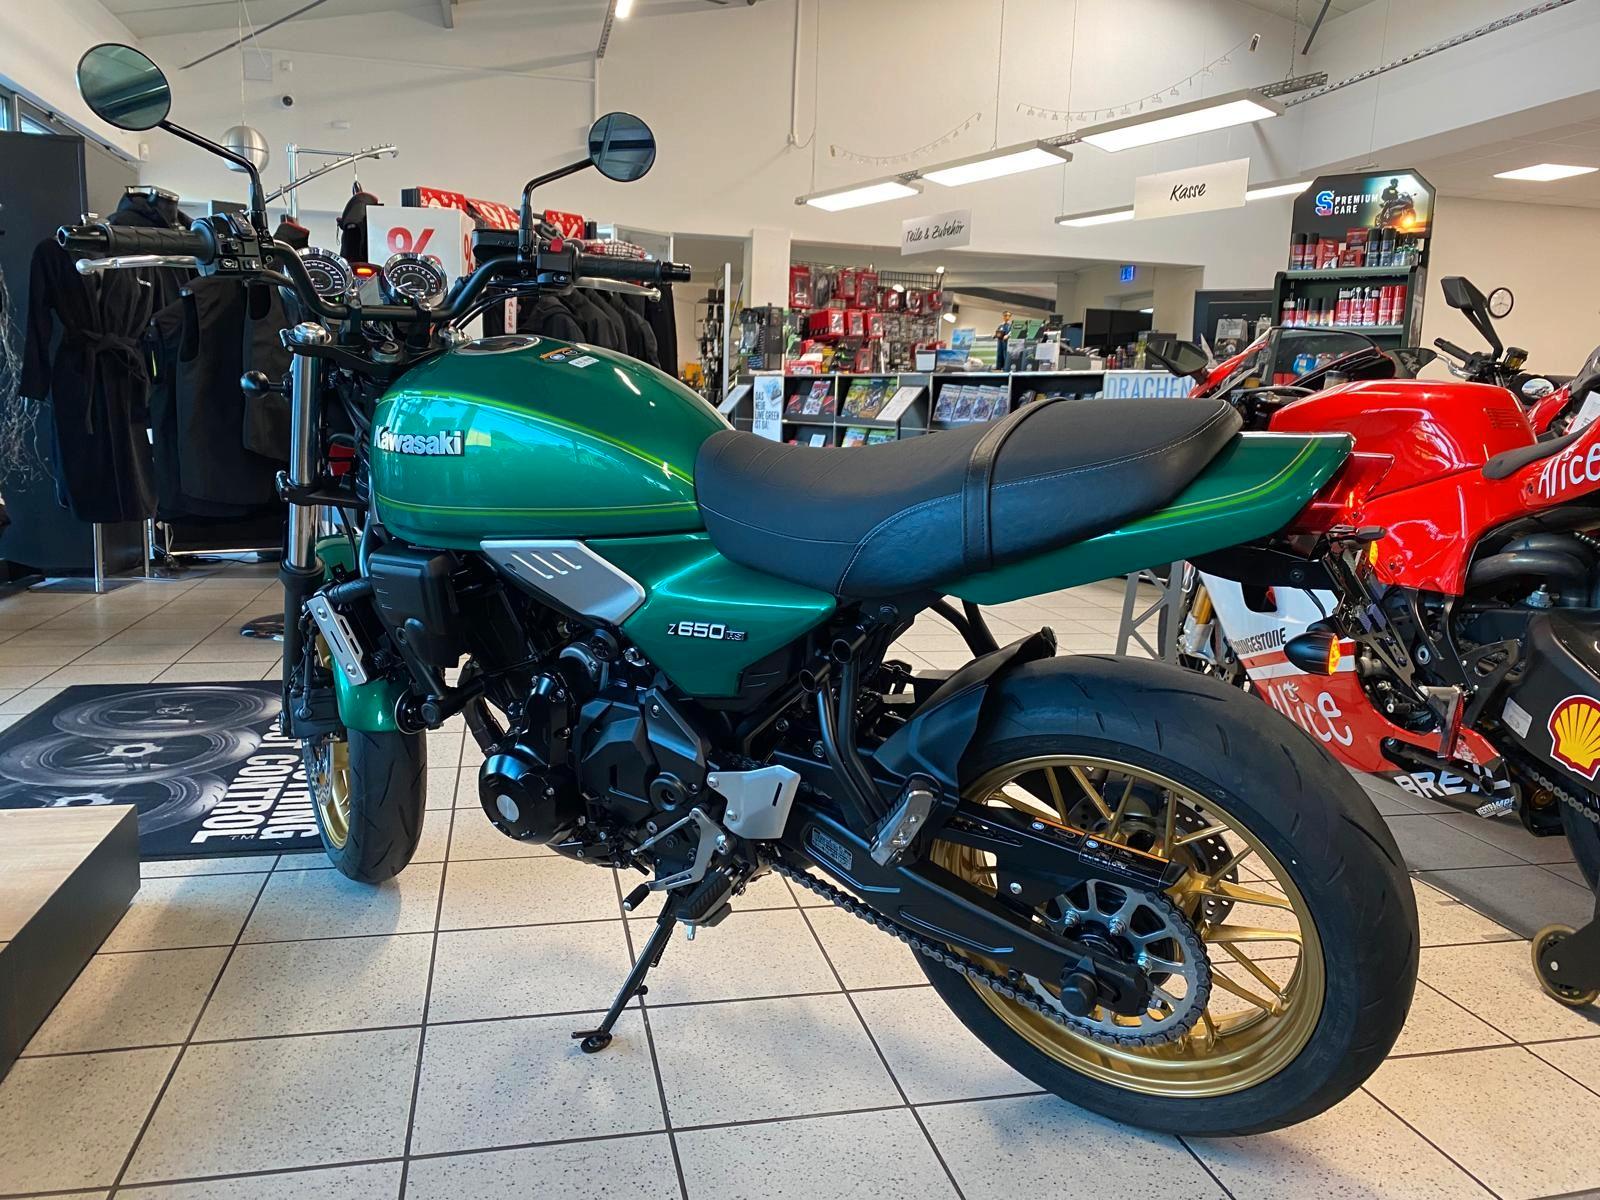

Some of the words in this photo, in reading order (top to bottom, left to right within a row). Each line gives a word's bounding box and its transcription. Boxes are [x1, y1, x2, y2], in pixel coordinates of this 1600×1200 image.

[1169, 183, 1207, 202] Kasse
[1334, 194, 1379, 206] PREMIUM
[1334, 205, 1358, 214] CARE
[906, 227, 923, 243] Teile
[931, 219, 965, 239] Zubehör
[1106, 377, 1193, 400] DRACHEN
[373, 424, 462, 455] Kawasaki
[1267, 682, 1353, 747] Alice
[190, 754, 299, 844] CONTROL
